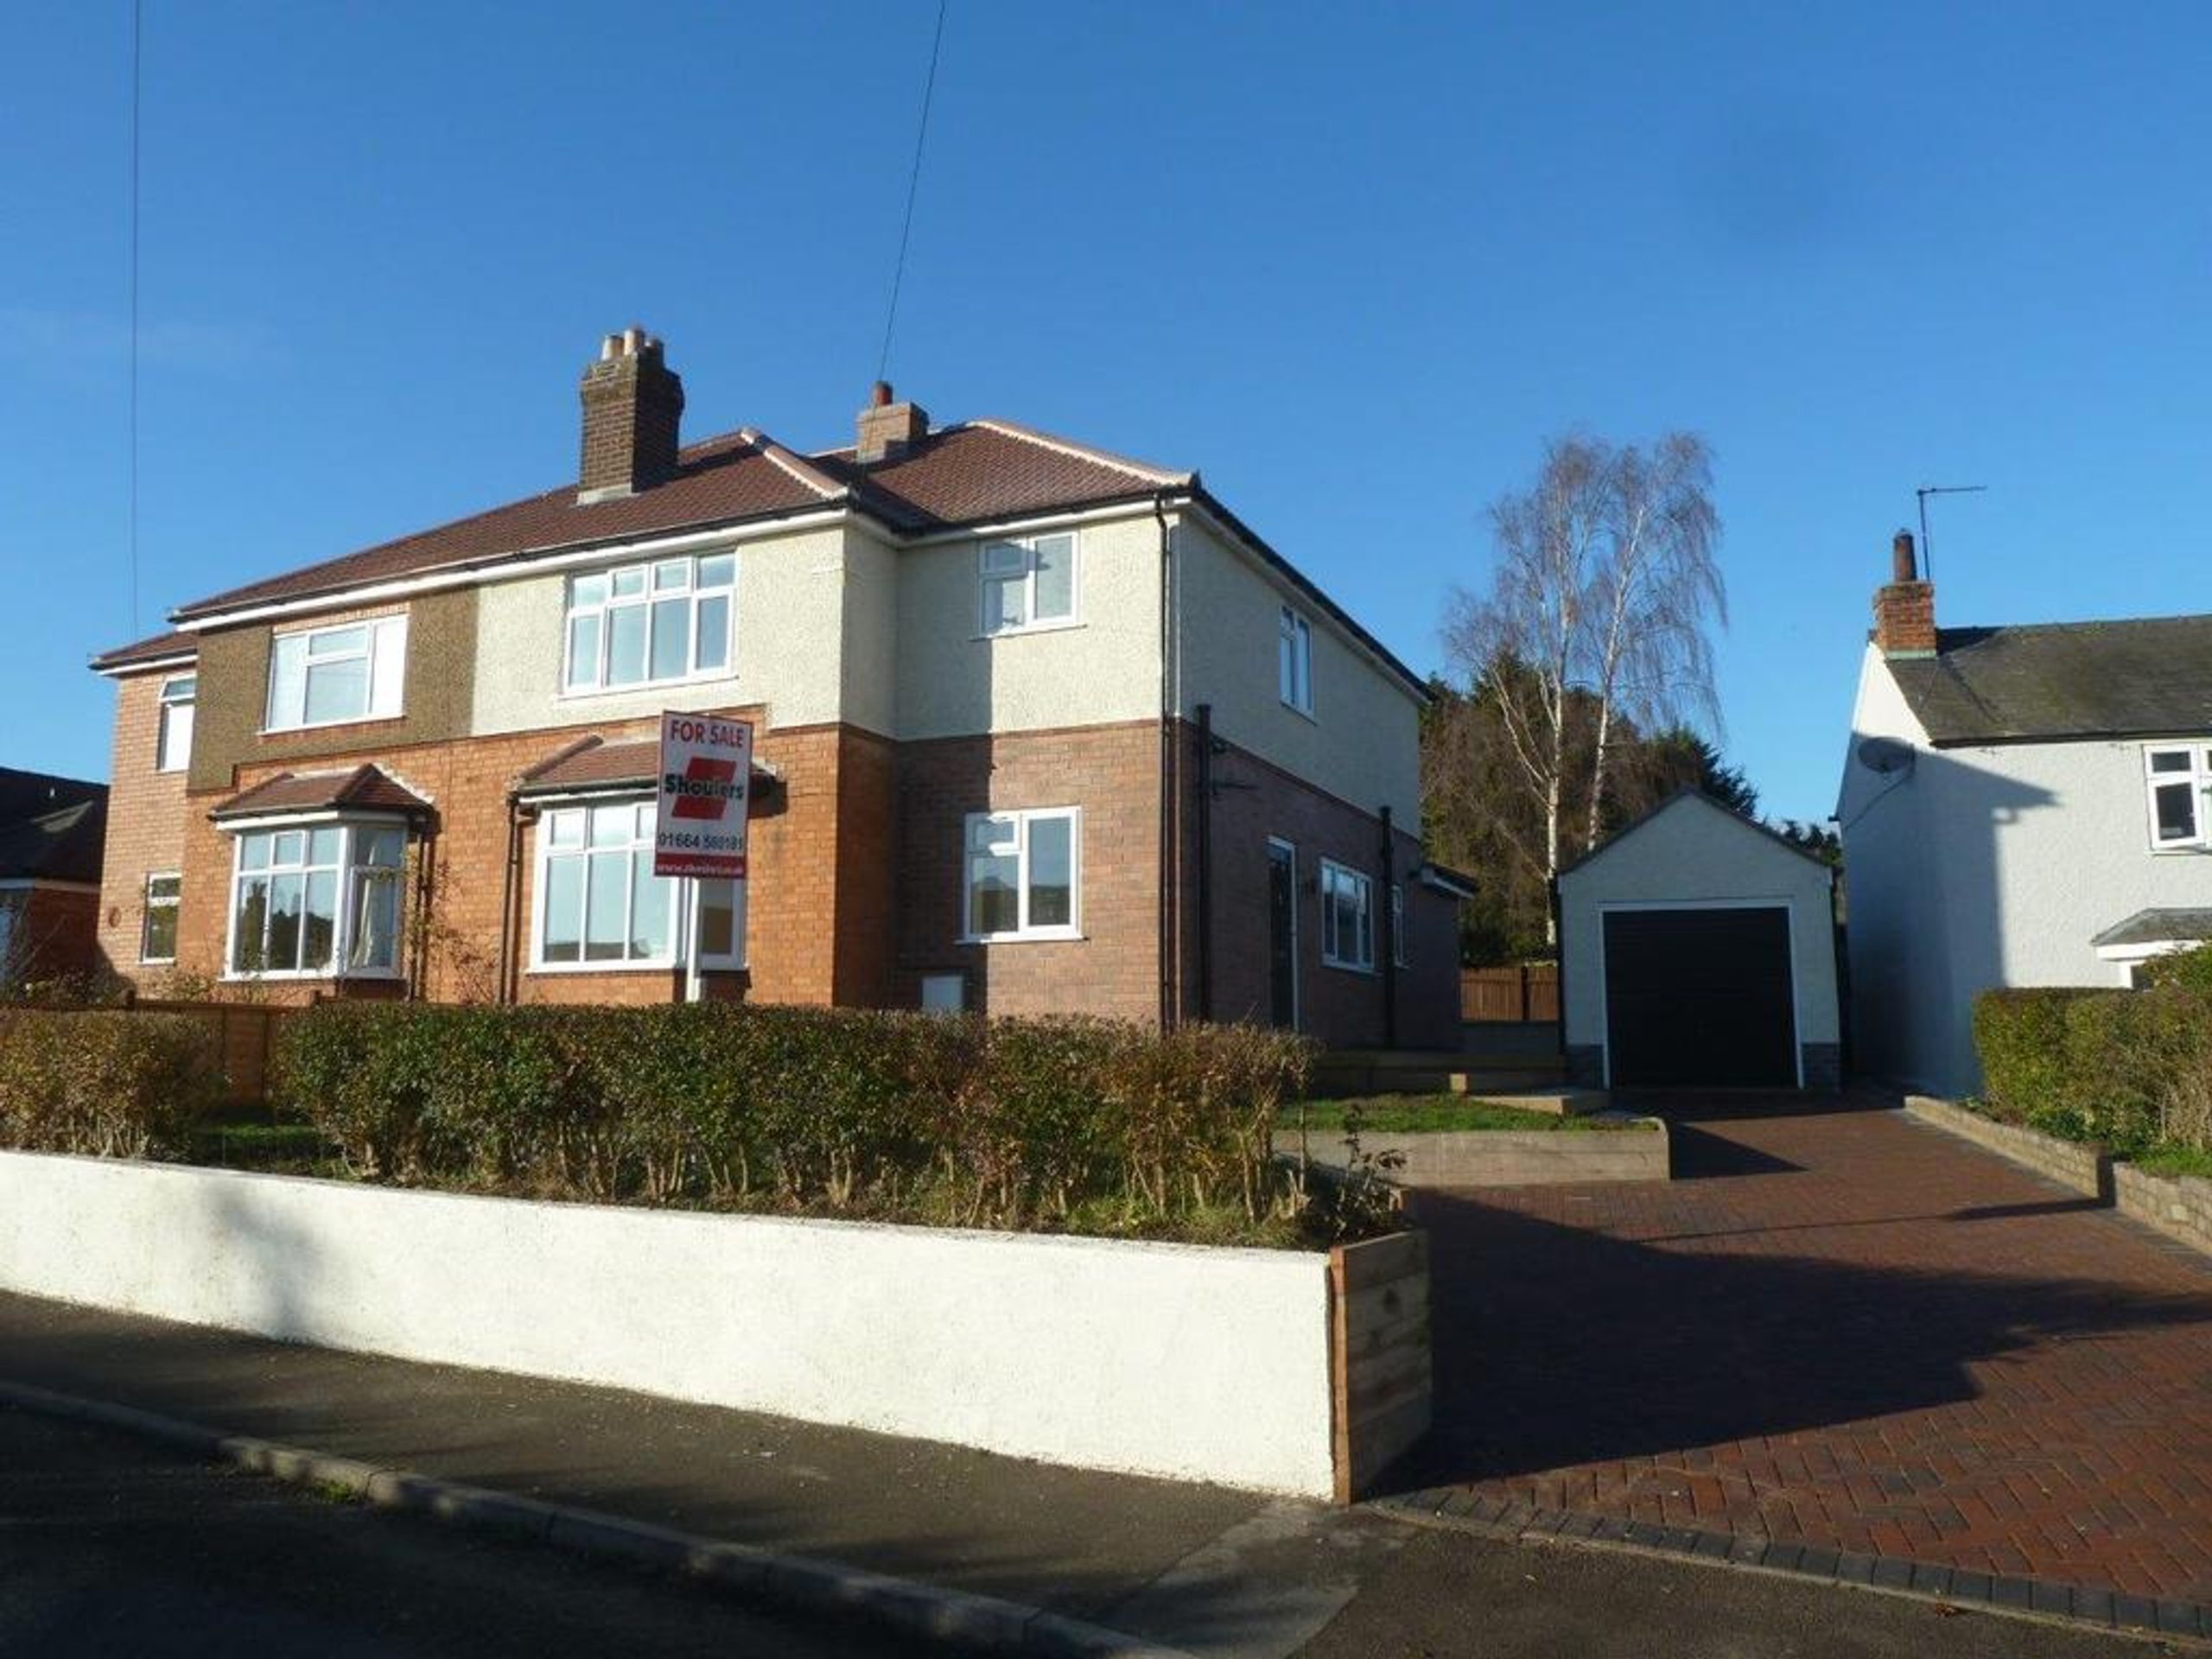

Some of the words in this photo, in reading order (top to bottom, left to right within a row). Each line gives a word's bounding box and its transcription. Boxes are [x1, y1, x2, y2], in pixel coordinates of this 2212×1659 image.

[671, 720, 705, 743] FOR
[709, 724, 745, 748] SALE
[664, 773, 744, 800] Shoulers
[658, 831, 701, 848] 01664
